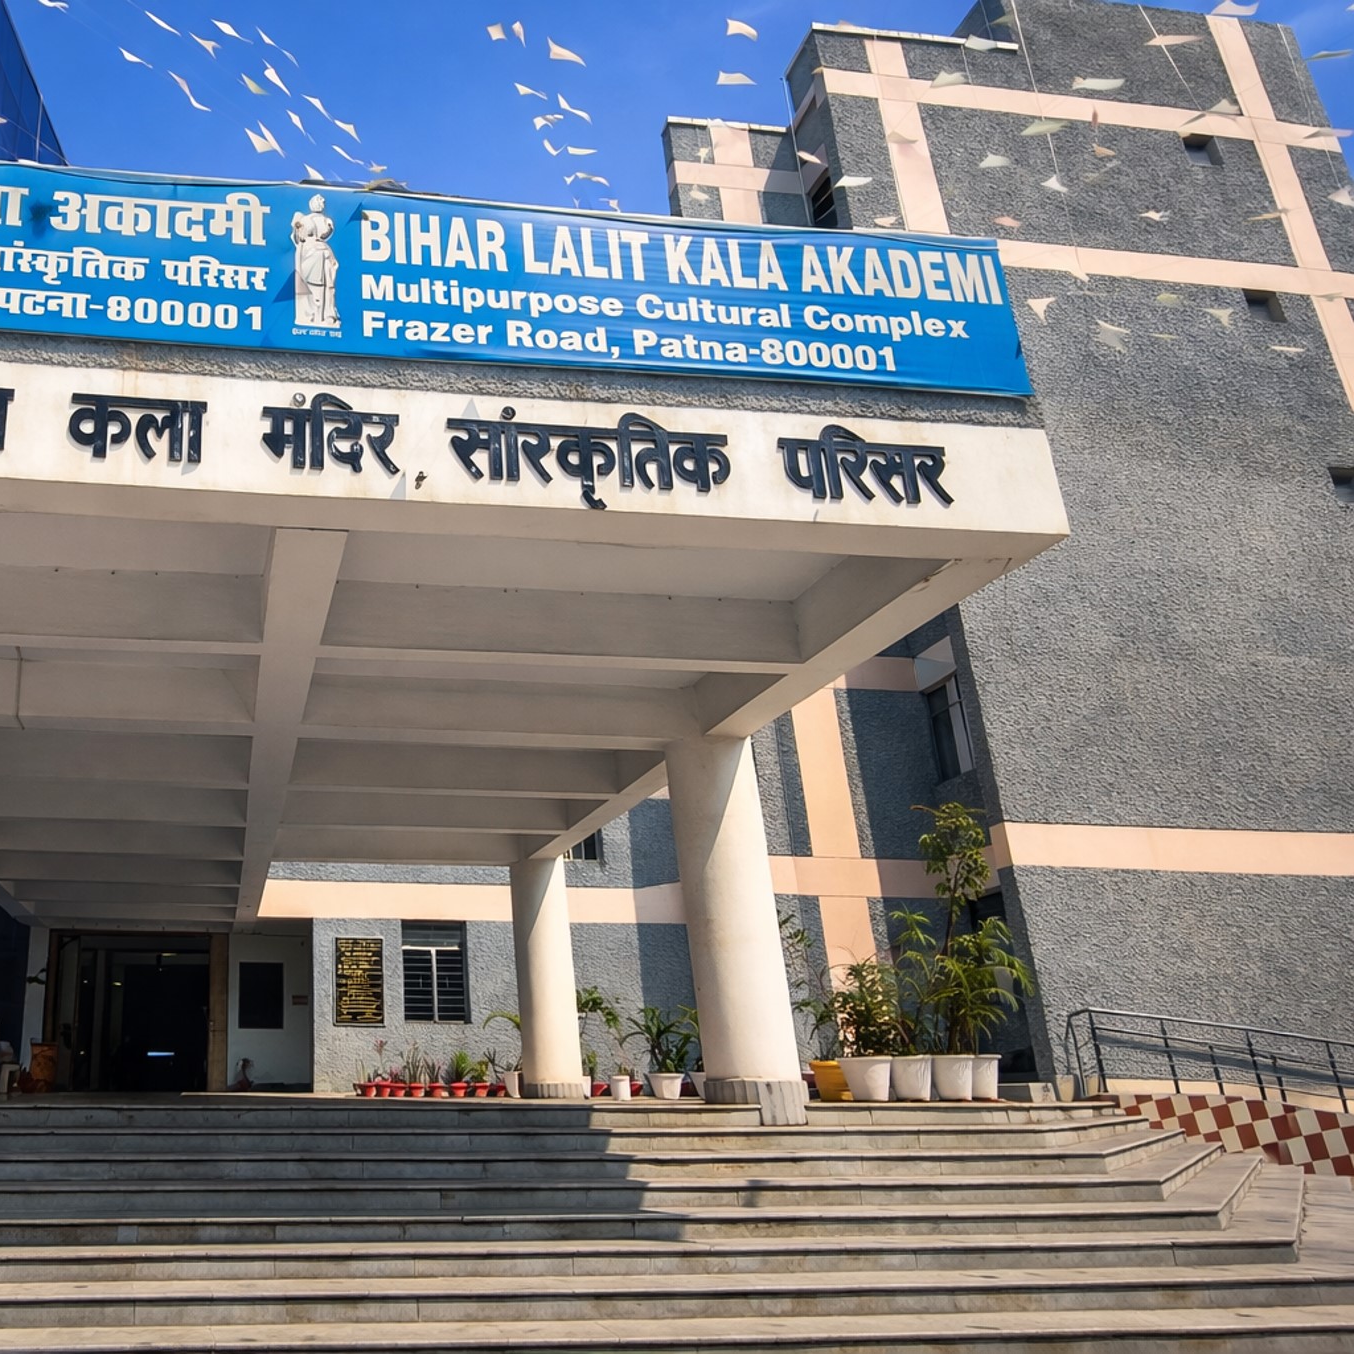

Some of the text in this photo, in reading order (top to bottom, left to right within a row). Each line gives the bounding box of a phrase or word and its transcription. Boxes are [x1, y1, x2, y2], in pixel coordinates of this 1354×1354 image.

[50, 191, 270, 247] अकादमी
[161, 255, 270, 291] परिसर
[361, 210, 1003, 305] BIHAR LALIT KALA AKADEMI
[361, 274, 970, 342] Multipurpose Cultural Complex
[363, 311, 896, 372] Frazer Road, Patna-800001
[68, 392, 208, 464] कला
[262, 393, 400, 475] मंदिर
[777, 423, 955, 505] परिसर
